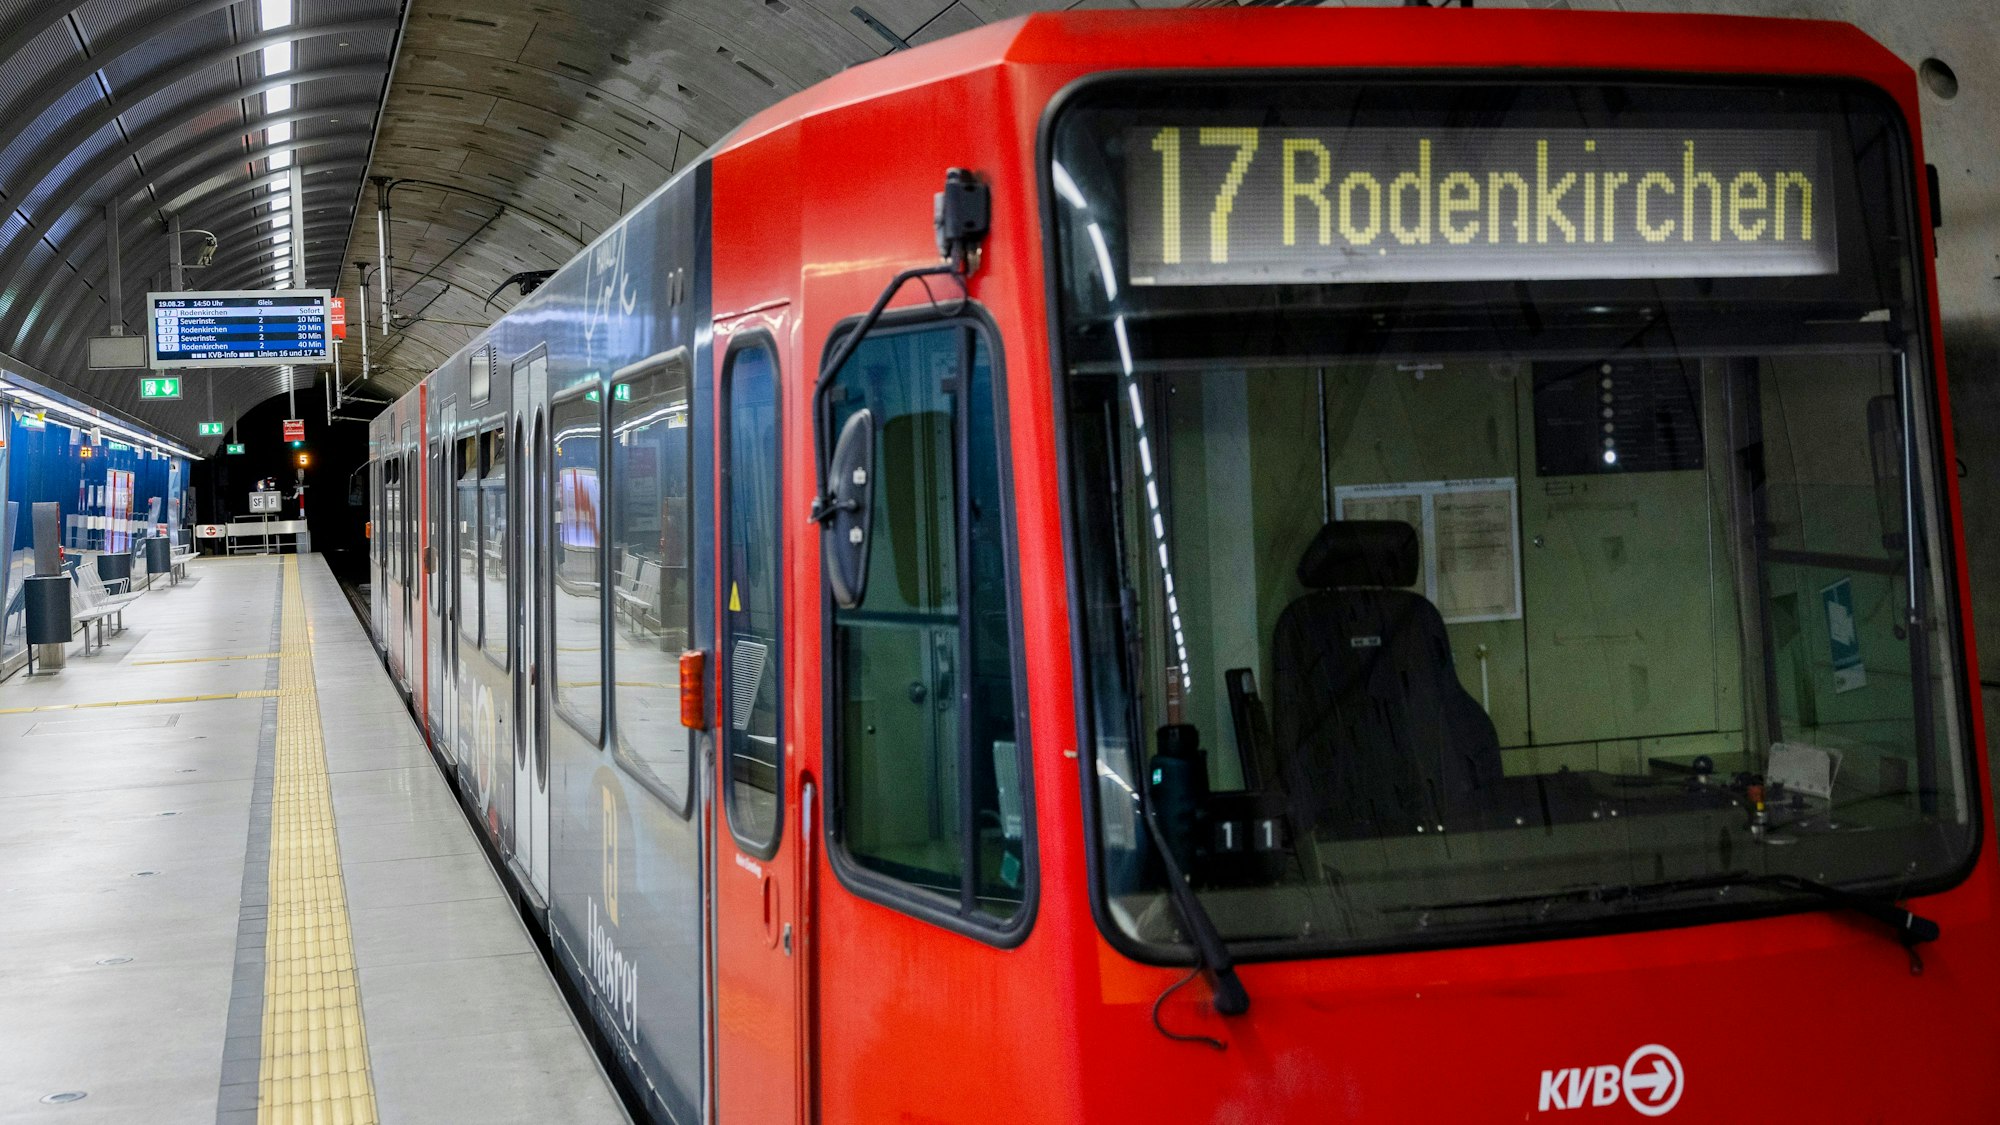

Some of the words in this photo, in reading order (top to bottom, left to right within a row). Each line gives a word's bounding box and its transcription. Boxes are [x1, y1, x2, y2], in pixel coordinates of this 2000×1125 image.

[1151, 126, 1259, 264] 17
[1282, 139, 1813, 246] Rodenkirchen
[300, 455, 308, 464] 5
[253, 498, 262, 507] SF
[587, 895, 638, 1045] Hasret
[1537, 1064, 1621, 1112] KVB
